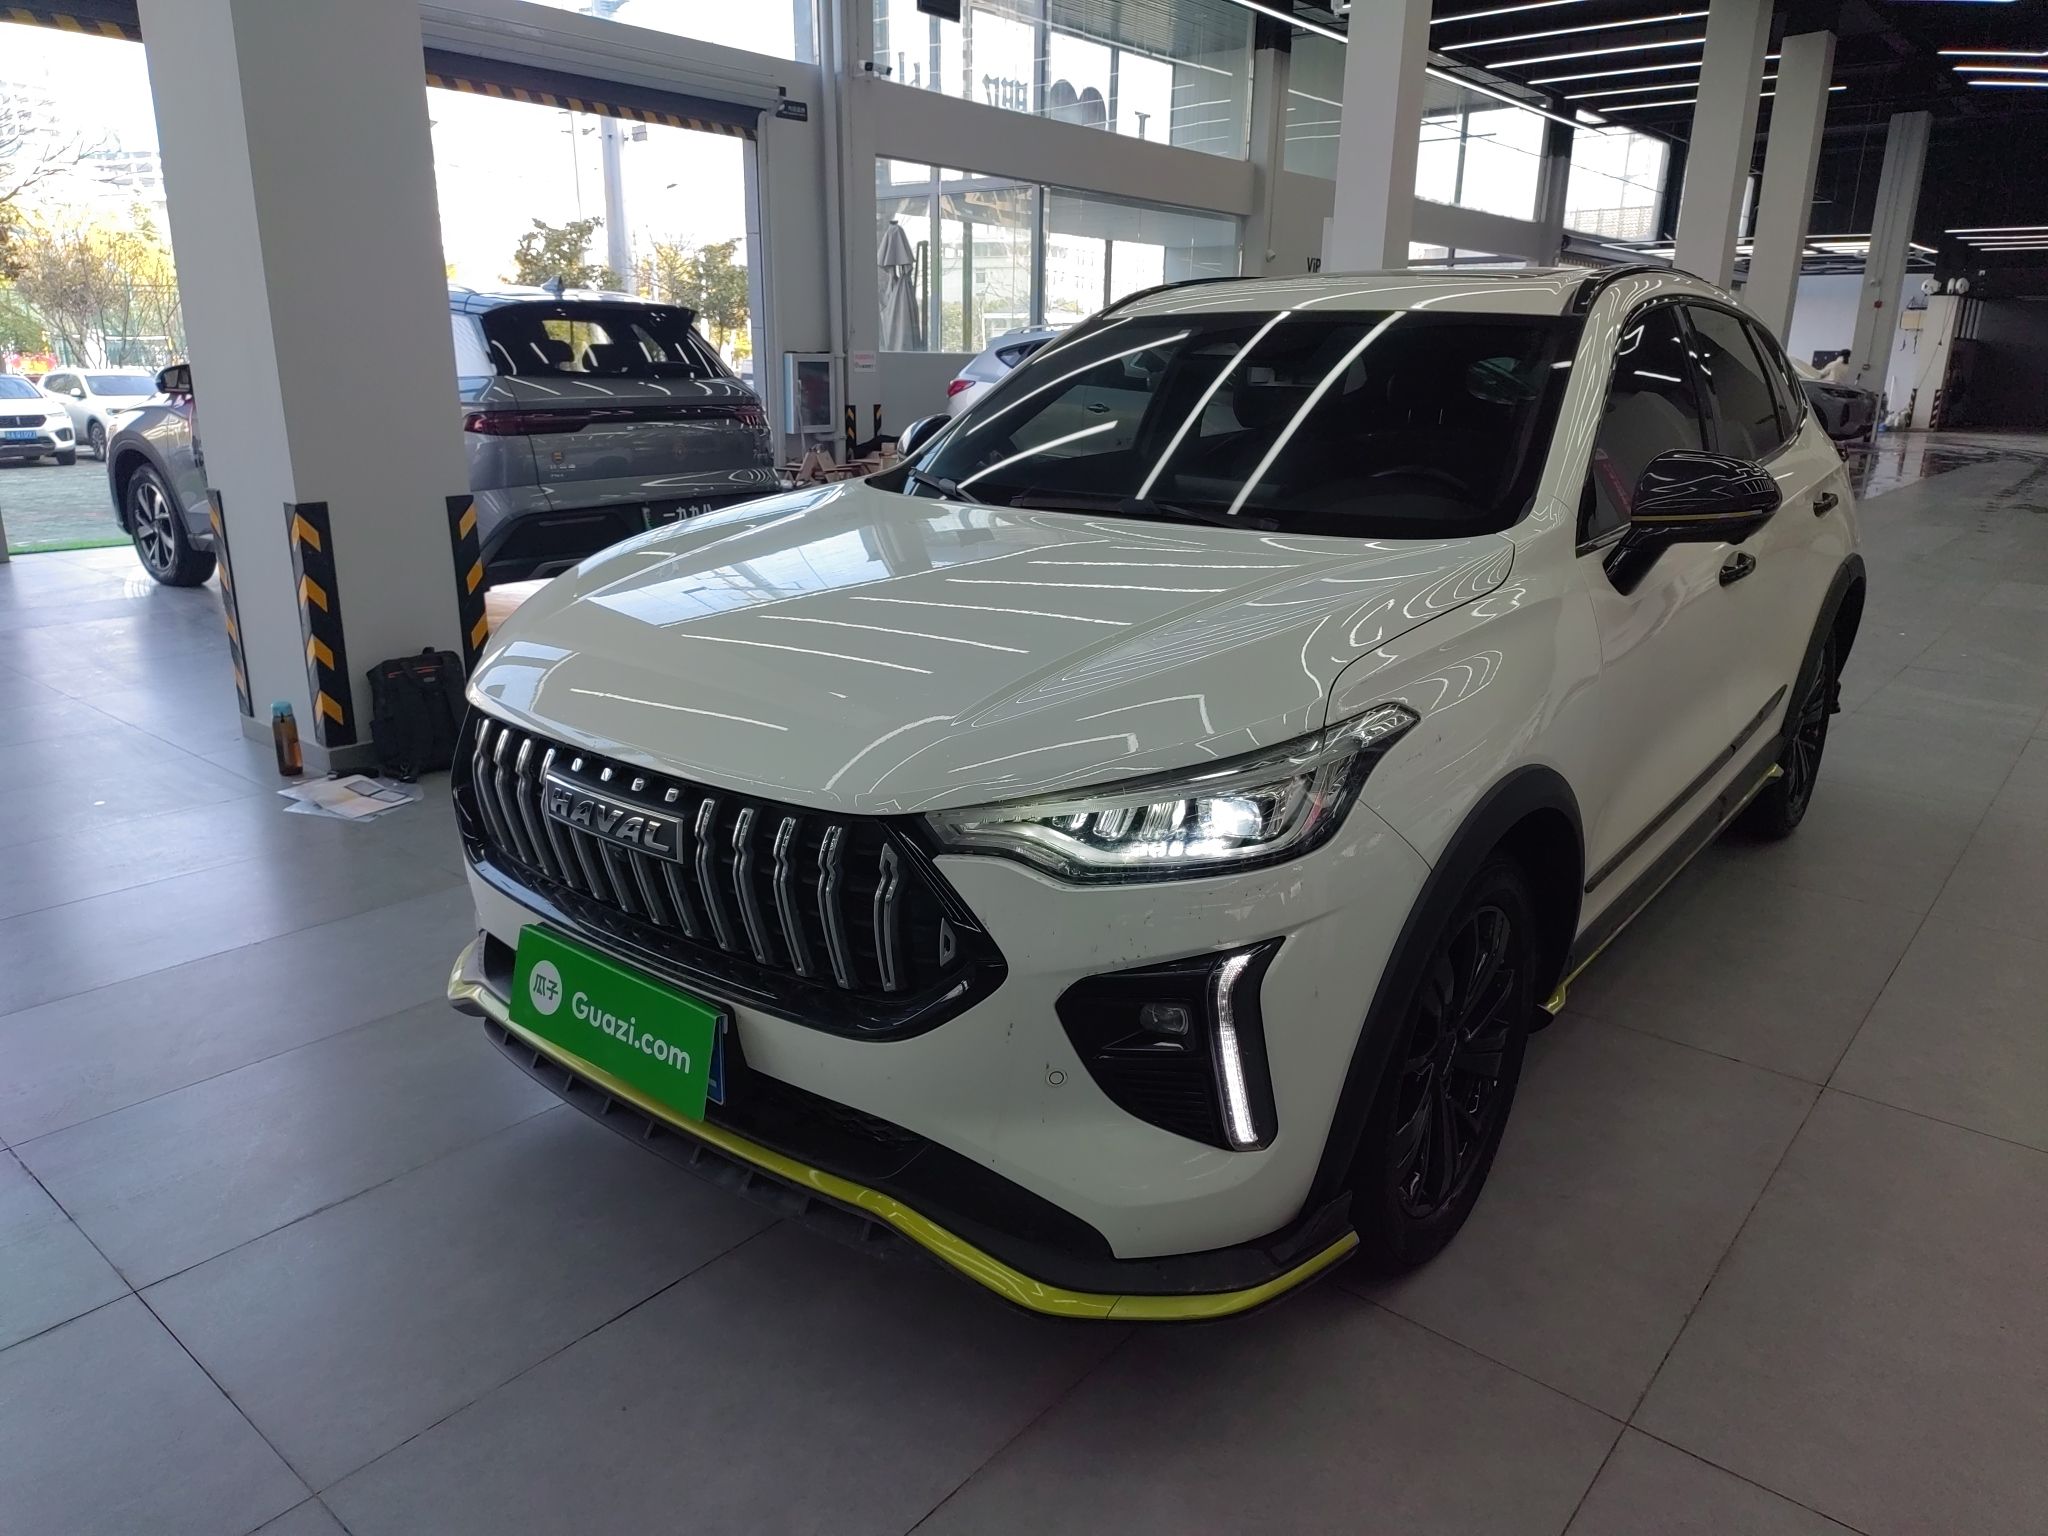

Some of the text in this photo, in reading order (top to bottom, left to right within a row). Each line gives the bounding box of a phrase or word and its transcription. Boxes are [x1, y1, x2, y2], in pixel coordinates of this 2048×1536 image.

[550, 787, 670, 852] HAVAL
[532, 973, 559, 1001] 瓜子
[571, 991, 691, 1074] Guazi.com
